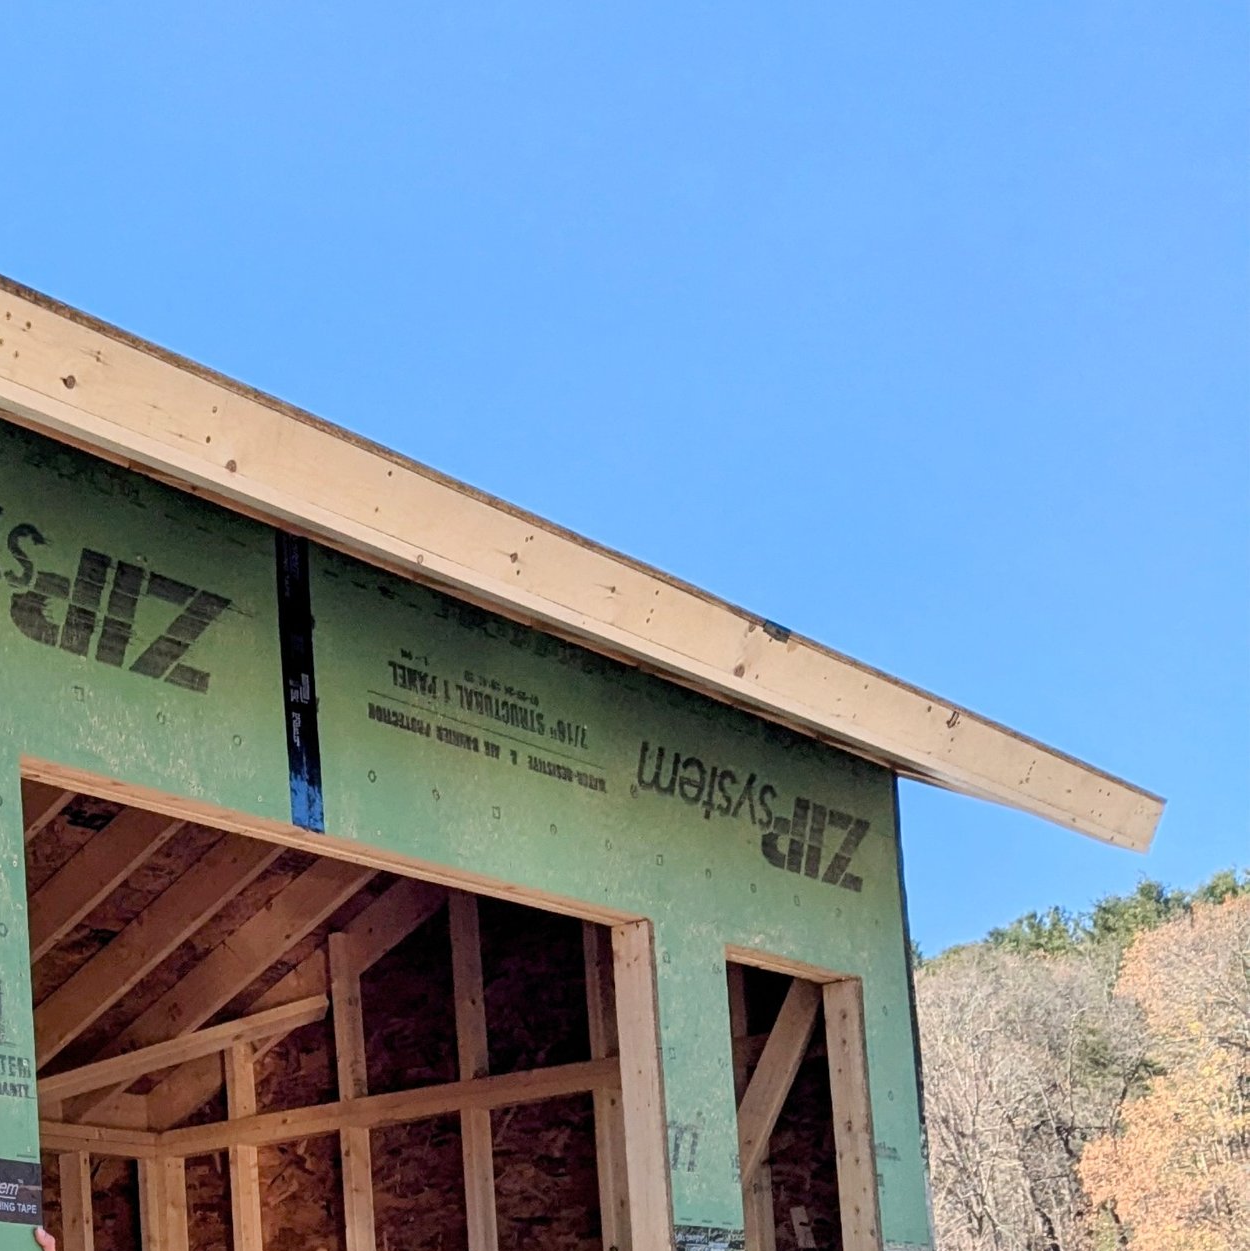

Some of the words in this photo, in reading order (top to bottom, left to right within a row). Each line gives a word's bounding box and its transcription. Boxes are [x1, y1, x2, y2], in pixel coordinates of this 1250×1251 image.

[388, 660, 437, 699] PANEL
[455, 684, 545, 735] STRUCTURAL
[16, 1203, 37, 1214] TAPE
